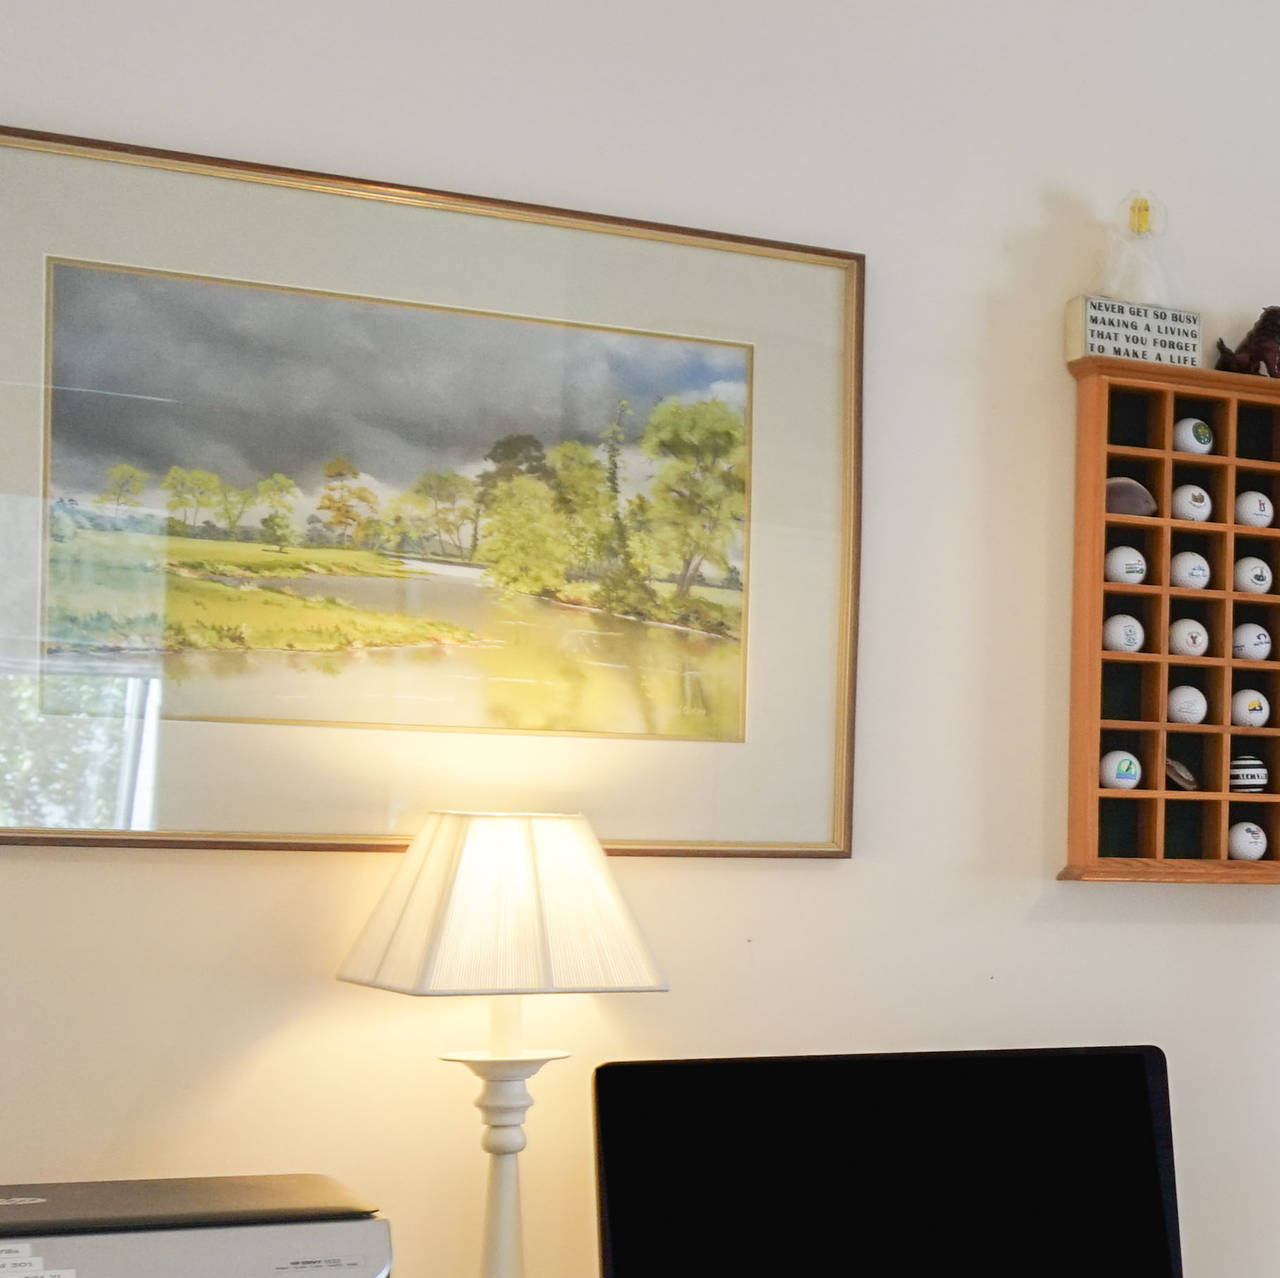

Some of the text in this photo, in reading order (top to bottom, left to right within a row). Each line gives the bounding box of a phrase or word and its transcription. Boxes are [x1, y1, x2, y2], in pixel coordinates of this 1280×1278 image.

[1090, 301, 1199, 325] NEVER GET SO BUSY
[1090, 315, 1198, 339] MAKING A LIVING
[1089, 329, 1198, 352] THAT YOU FORGET
[1089, 343, 1198, 367] TO MAKE A LIFE
